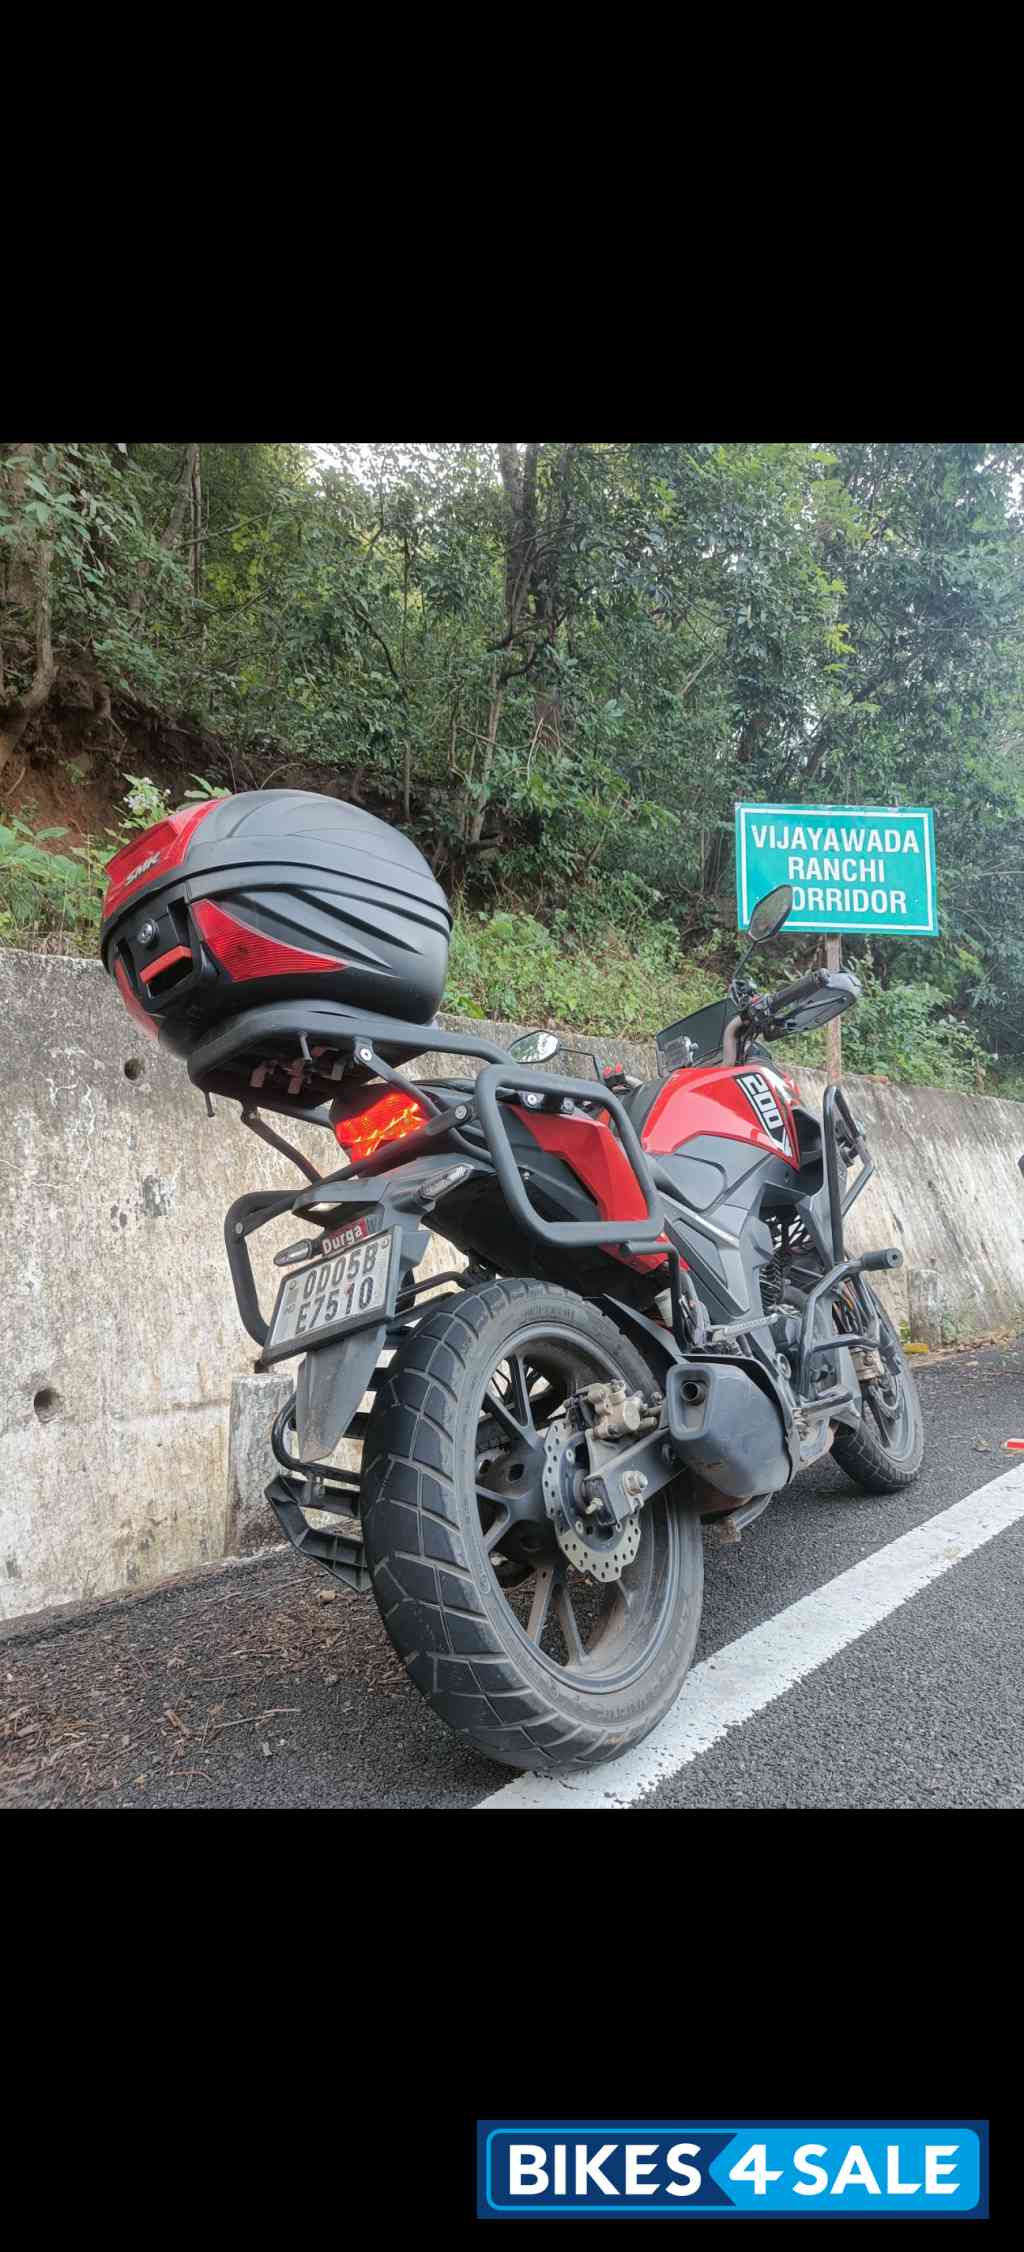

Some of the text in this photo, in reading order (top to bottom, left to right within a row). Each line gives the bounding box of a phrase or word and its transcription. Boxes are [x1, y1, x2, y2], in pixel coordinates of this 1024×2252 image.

[751, 824, 920, 853] VIJAYAWADA
[788, 856, 885, 883] RANCHI
[790, 886, 908, 914] ORRIDOR
[740, 1074, 784, 1129] 200
[322, 1225, 363, 1254] Durga
[296, 1276, 374, 1334] E7510
